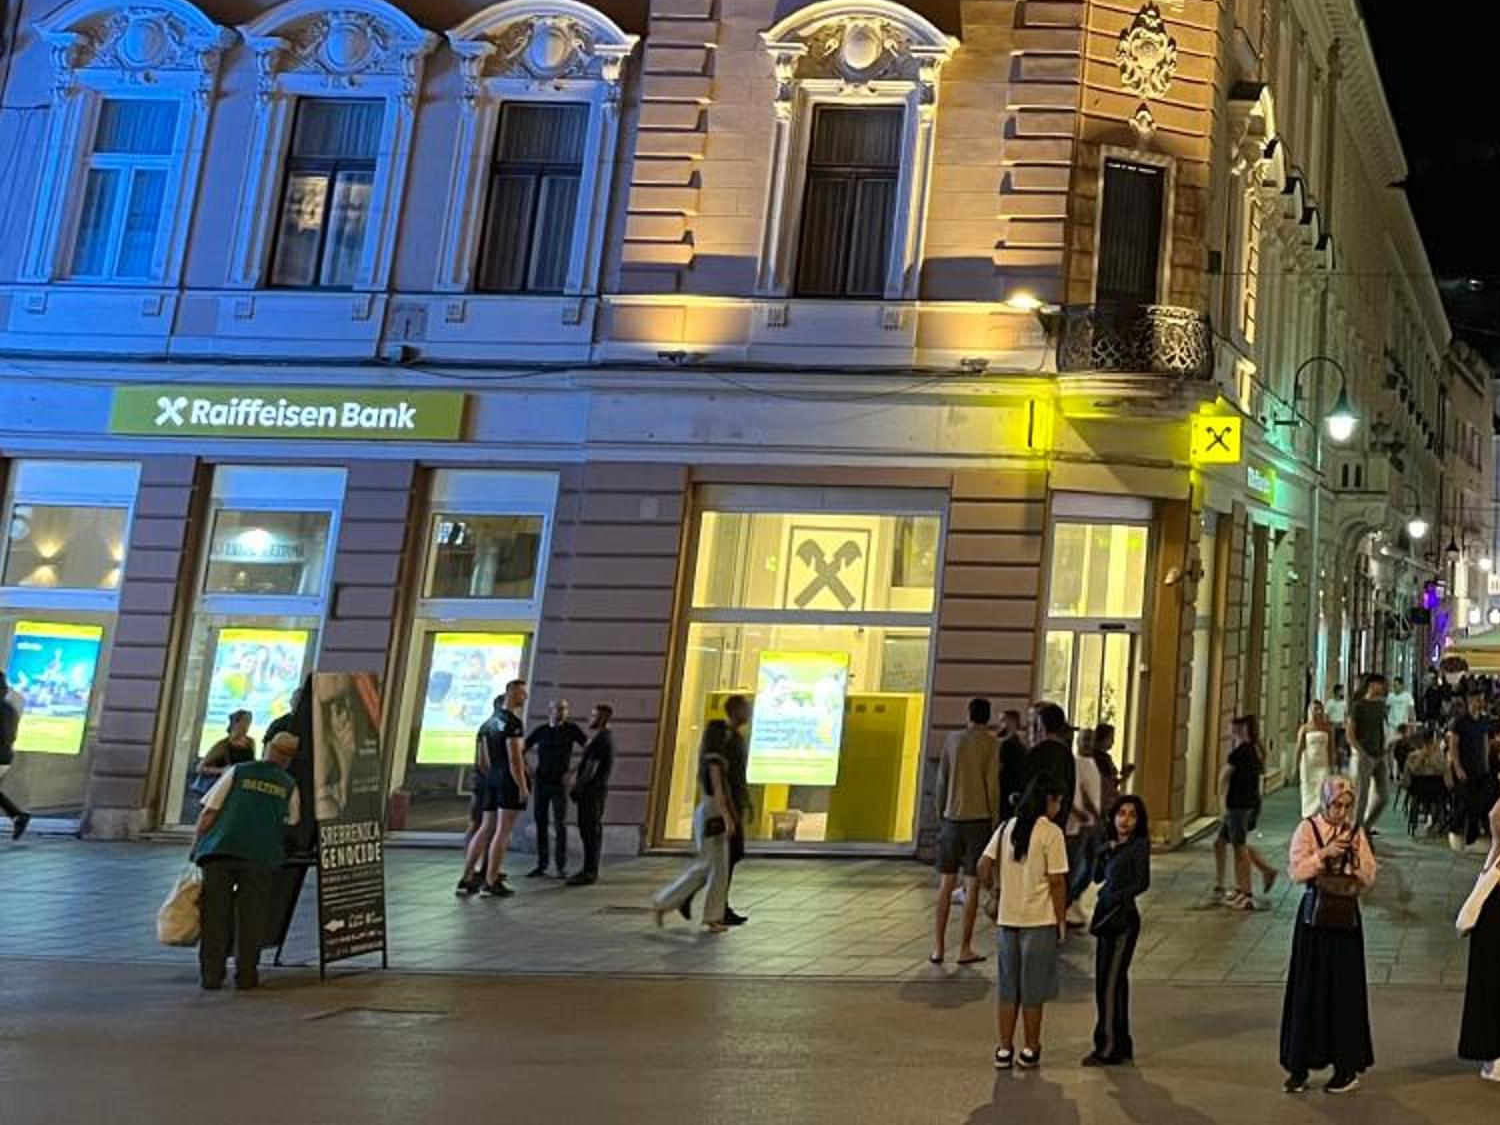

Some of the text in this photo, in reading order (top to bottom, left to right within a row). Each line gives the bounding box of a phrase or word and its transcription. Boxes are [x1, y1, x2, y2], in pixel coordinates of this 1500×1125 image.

[190, 398, 417, 429] Raiffeisen Bank
[320, 842, 382, 870] GENOCIDE
